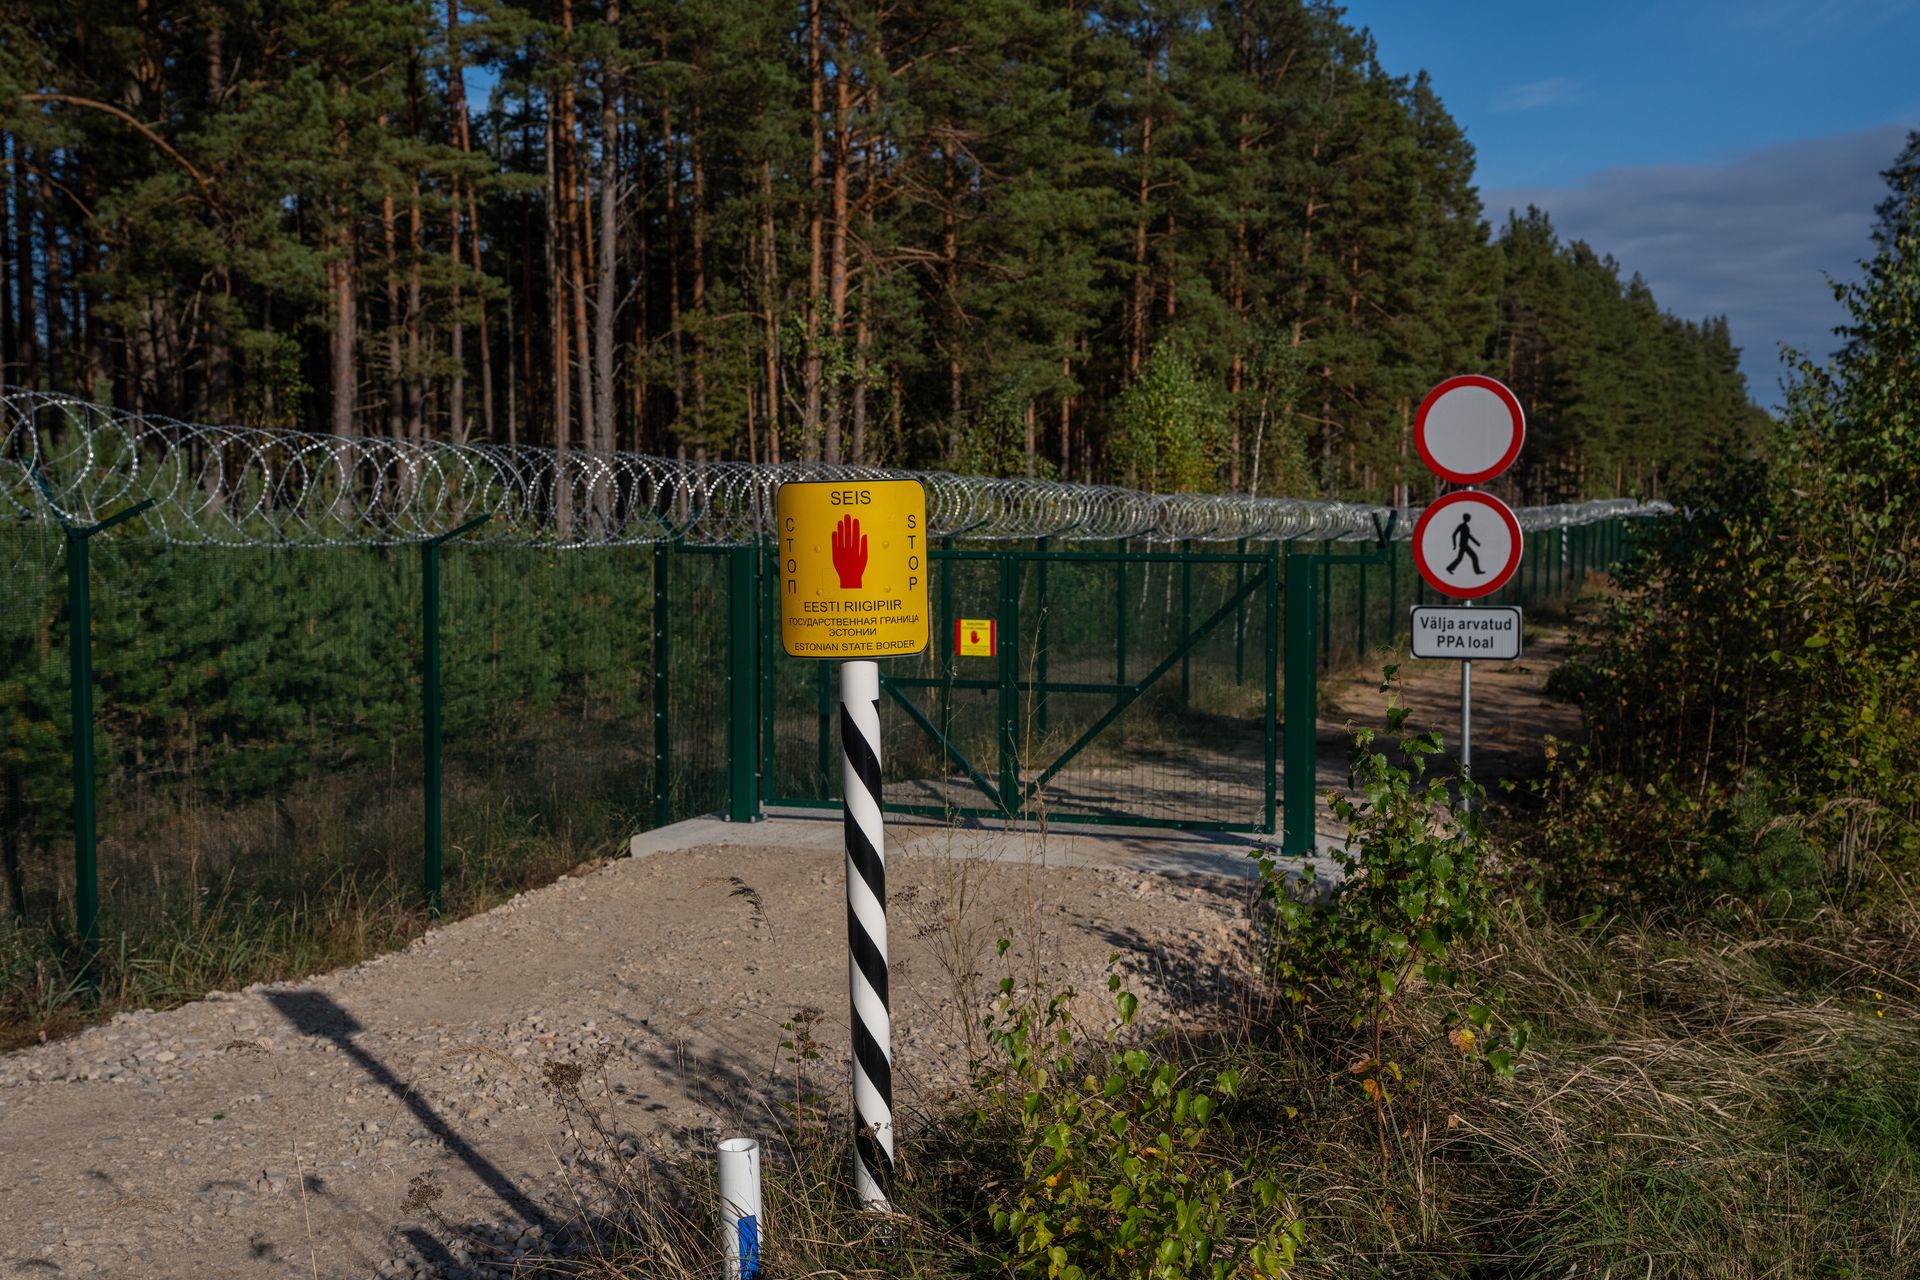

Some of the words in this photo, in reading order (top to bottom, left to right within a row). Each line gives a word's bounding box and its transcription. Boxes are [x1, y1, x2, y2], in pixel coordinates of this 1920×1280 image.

[831, 490, 872, 505] SEIS
[785, 517, 797, 594] СТОП
[907, 514, 919, 591] STOP
[804, 601, 840, 612] EESTI
[844, 599, 903, 612] RIIGIPIIR
[788, 617, 877, 627] ГОСУДАРСТВЕННАЯ
[879, 614, 920, 625] ГРАНИЦА
[1420, 616, 1455, 632] Välja
[1458, 618, 1512, 631] arvatud
[828, 628, 877, 637] ЭСТОНИИ
[794, 642, 839, 651] ESTONIAN
[841, 642, 873, 651] STATE
[875, 640, 915, 650] BORDER
[1437, 635, 1465, 648] PPA
[1468, 636, 1494, 648] loal
